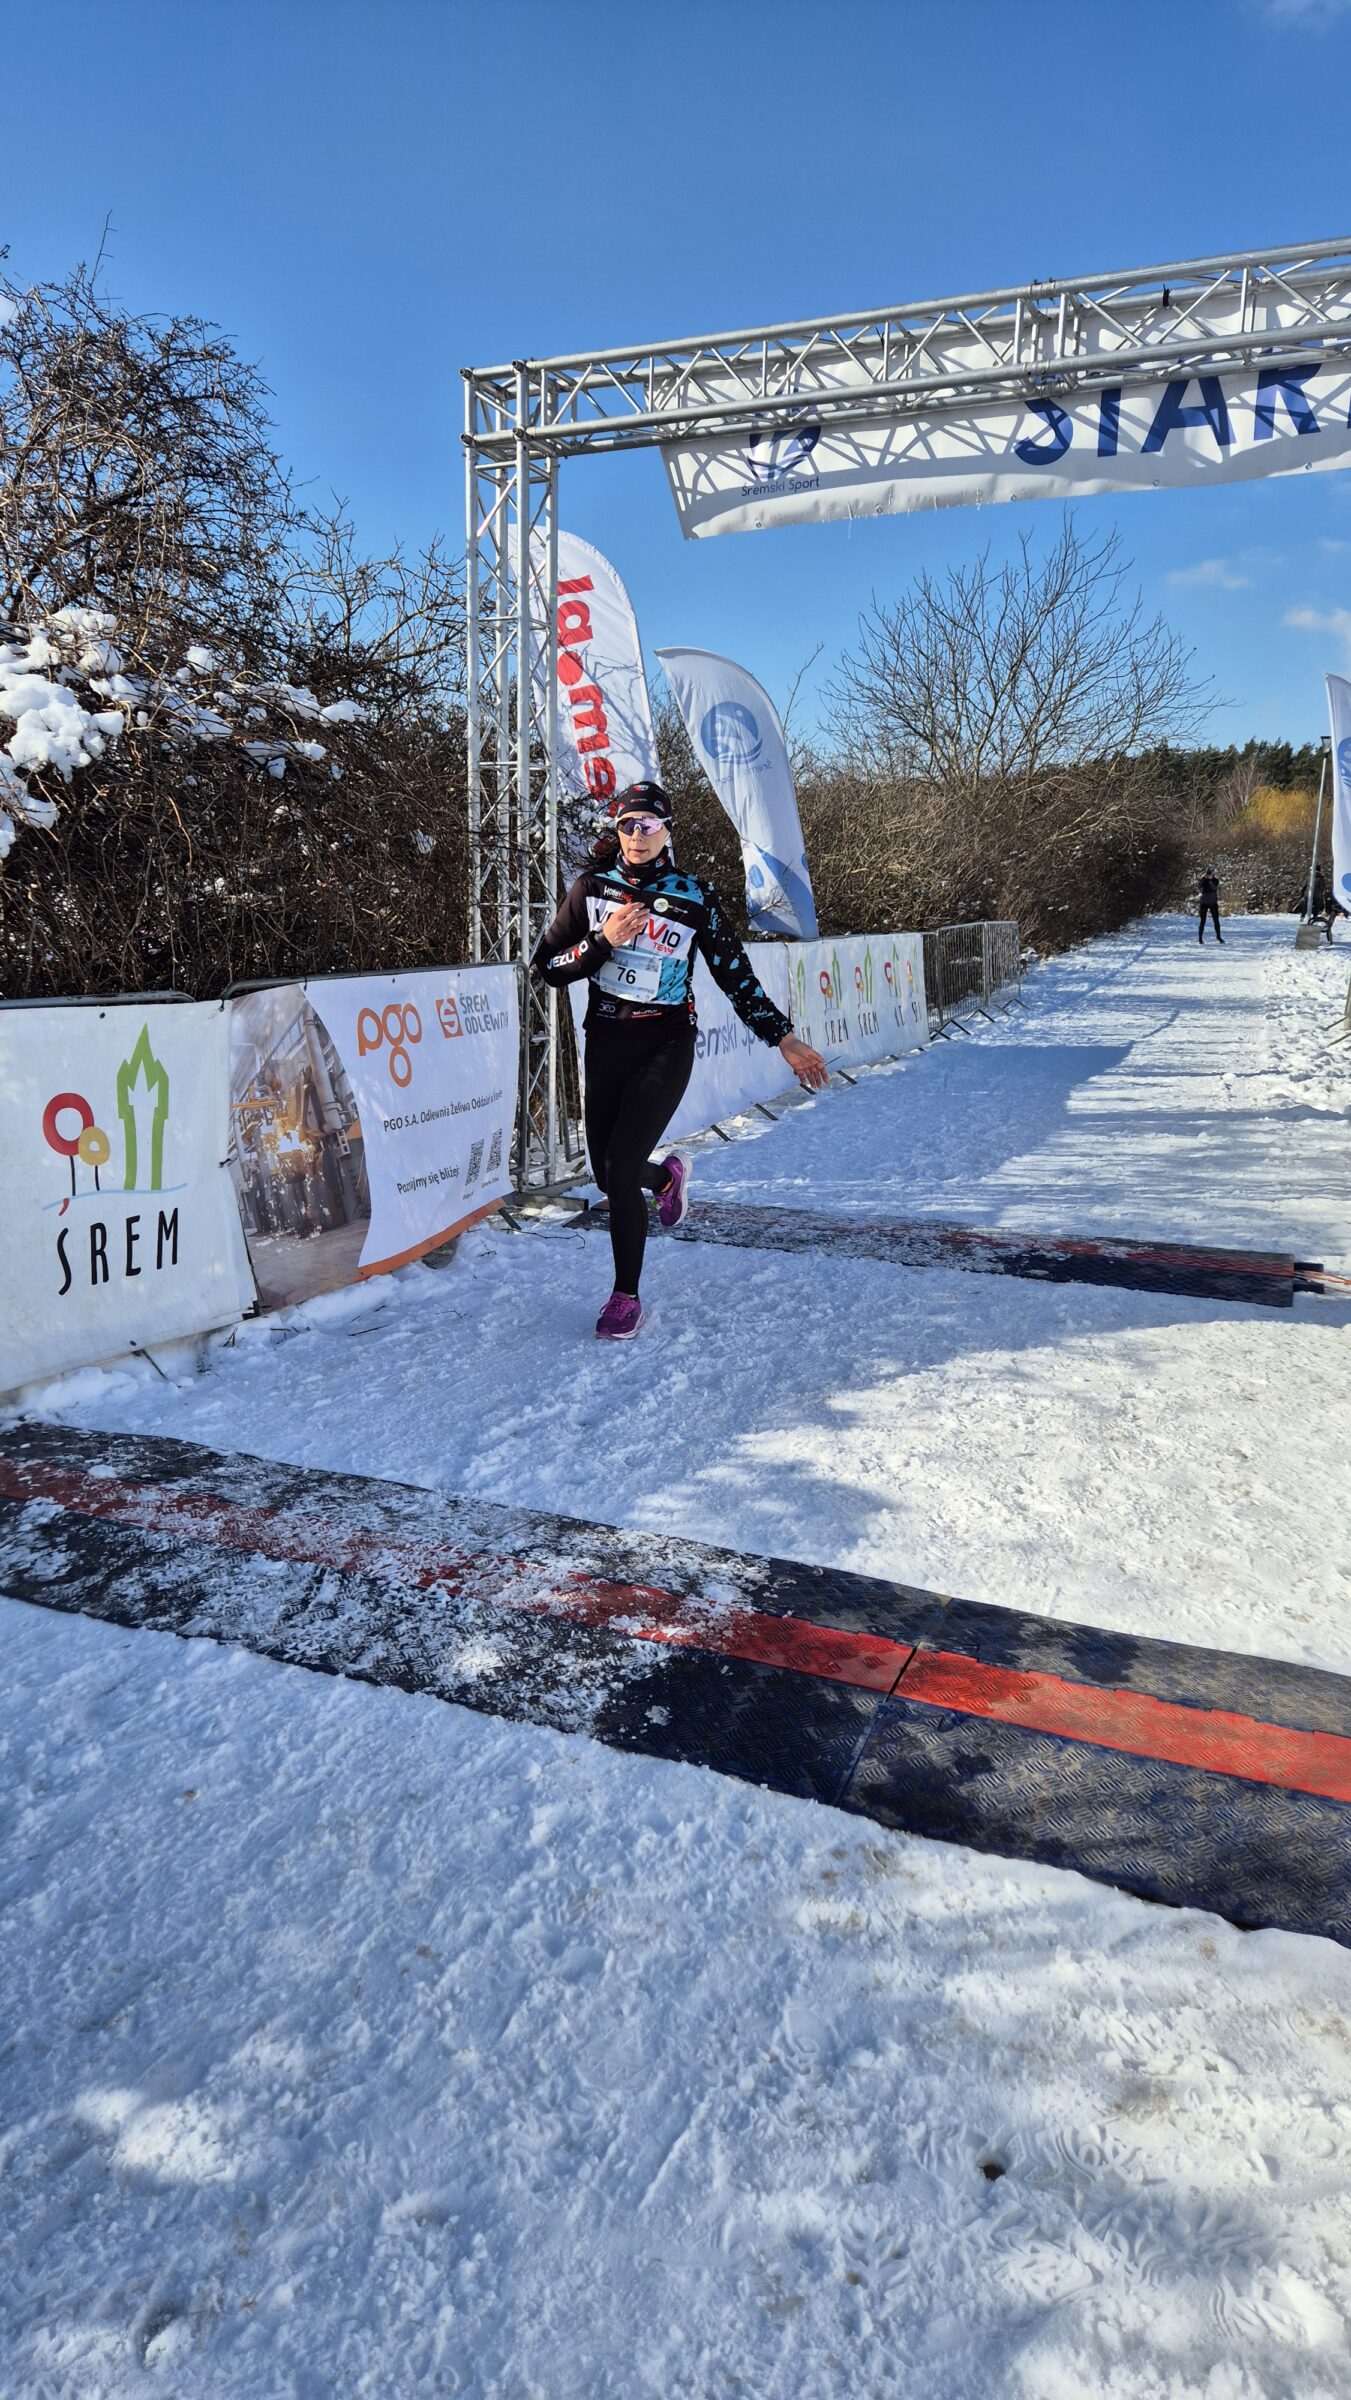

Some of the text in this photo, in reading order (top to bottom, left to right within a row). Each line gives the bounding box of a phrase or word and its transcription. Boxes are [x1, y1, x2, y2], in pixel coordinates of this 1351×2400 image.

[1013, 340, 1351, 466] STAR
[741, 476, 820, 497] Śremski Sport
[617, 966, 637, 984] 76
[459, 993, 490, 1014] ŚREM
[696, 1012, 738, 1059] emski
[383, 1117, 403, 1132] PGO
[405, 1114, 419, 1128] S.A.
[420, 1106, 451, 1123] Odlewnia
[450, 1101, 471, 1115] Żeliwa
[428, 1172, 440, 1184] się
[57, 1198, 178, 1295] ŚREM
